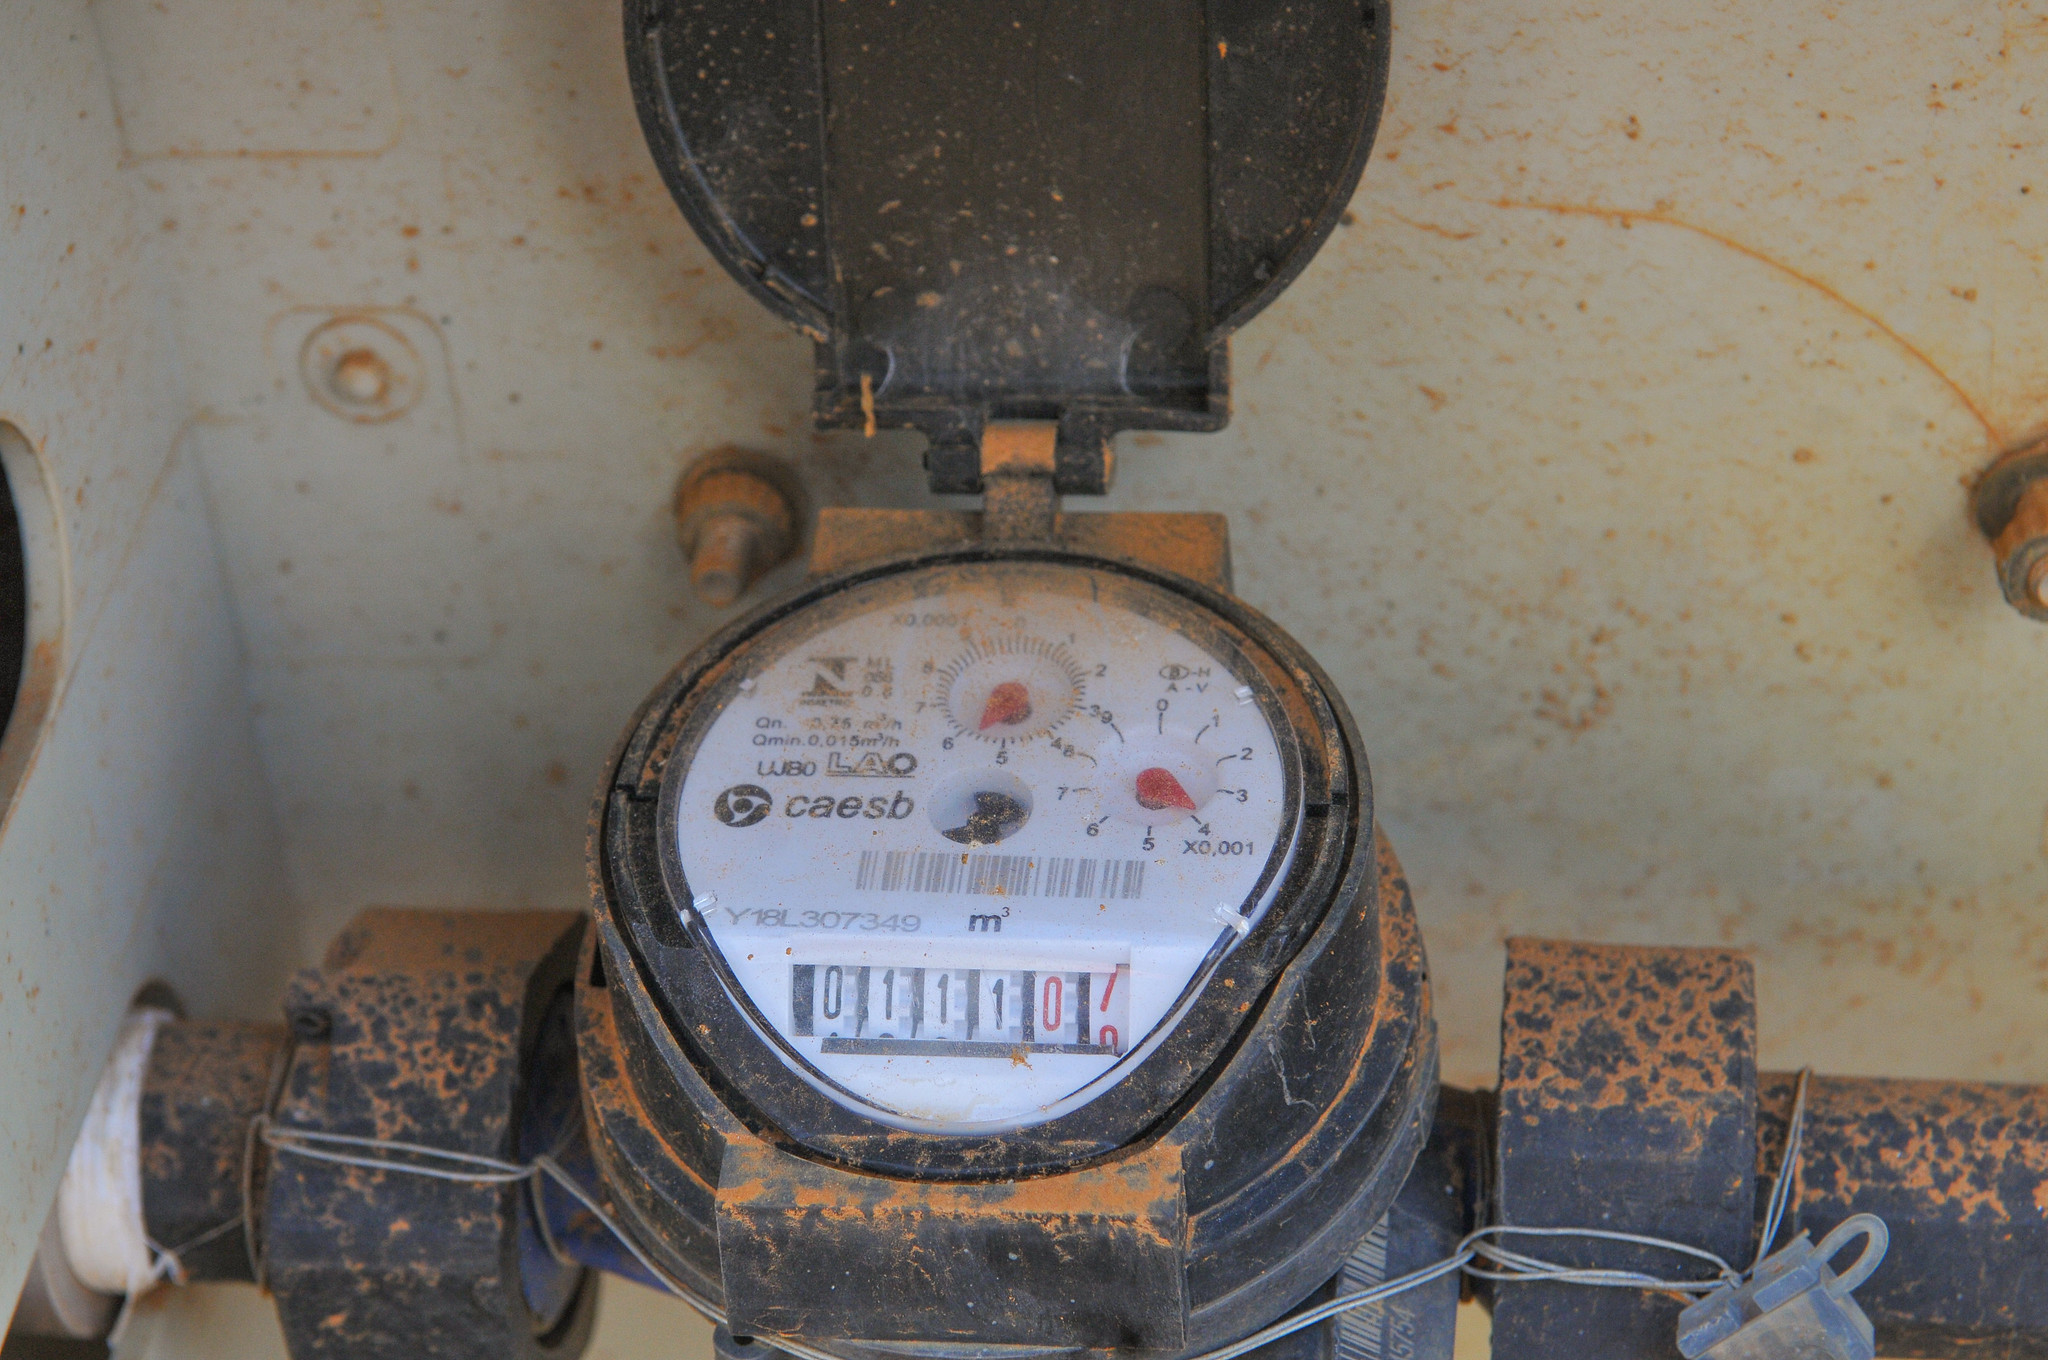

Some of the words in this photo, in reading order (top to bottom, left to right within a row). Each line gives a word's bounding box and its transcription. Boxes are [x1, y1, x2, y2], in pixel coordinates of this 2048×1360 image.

[1095, 664, 1108, 677] 2
[915, 701, 926, 714] 7
[1156, 698, 1169, 712] 0
[1101, 710, 1113, 724] 9
[1212, 714, 1220, 728] 1
[942, 737, 954, 751] 6
[996, 750, 1009, 765] 5
[1240, 747, 1253, 761] 2
[1057, 786, 1069, 800] 7
[1236, 789, 1248, 802] 3
[785, 789, 915, 819] caesb
[1086, 822, 1099, 837] 6
[1198, 823, 1211, 836] 4
[1142, 838, 1155, 851] 5
[1182, 840, 1254, 857] X0,001
[724, 906, 922, 933] Y18L307349
